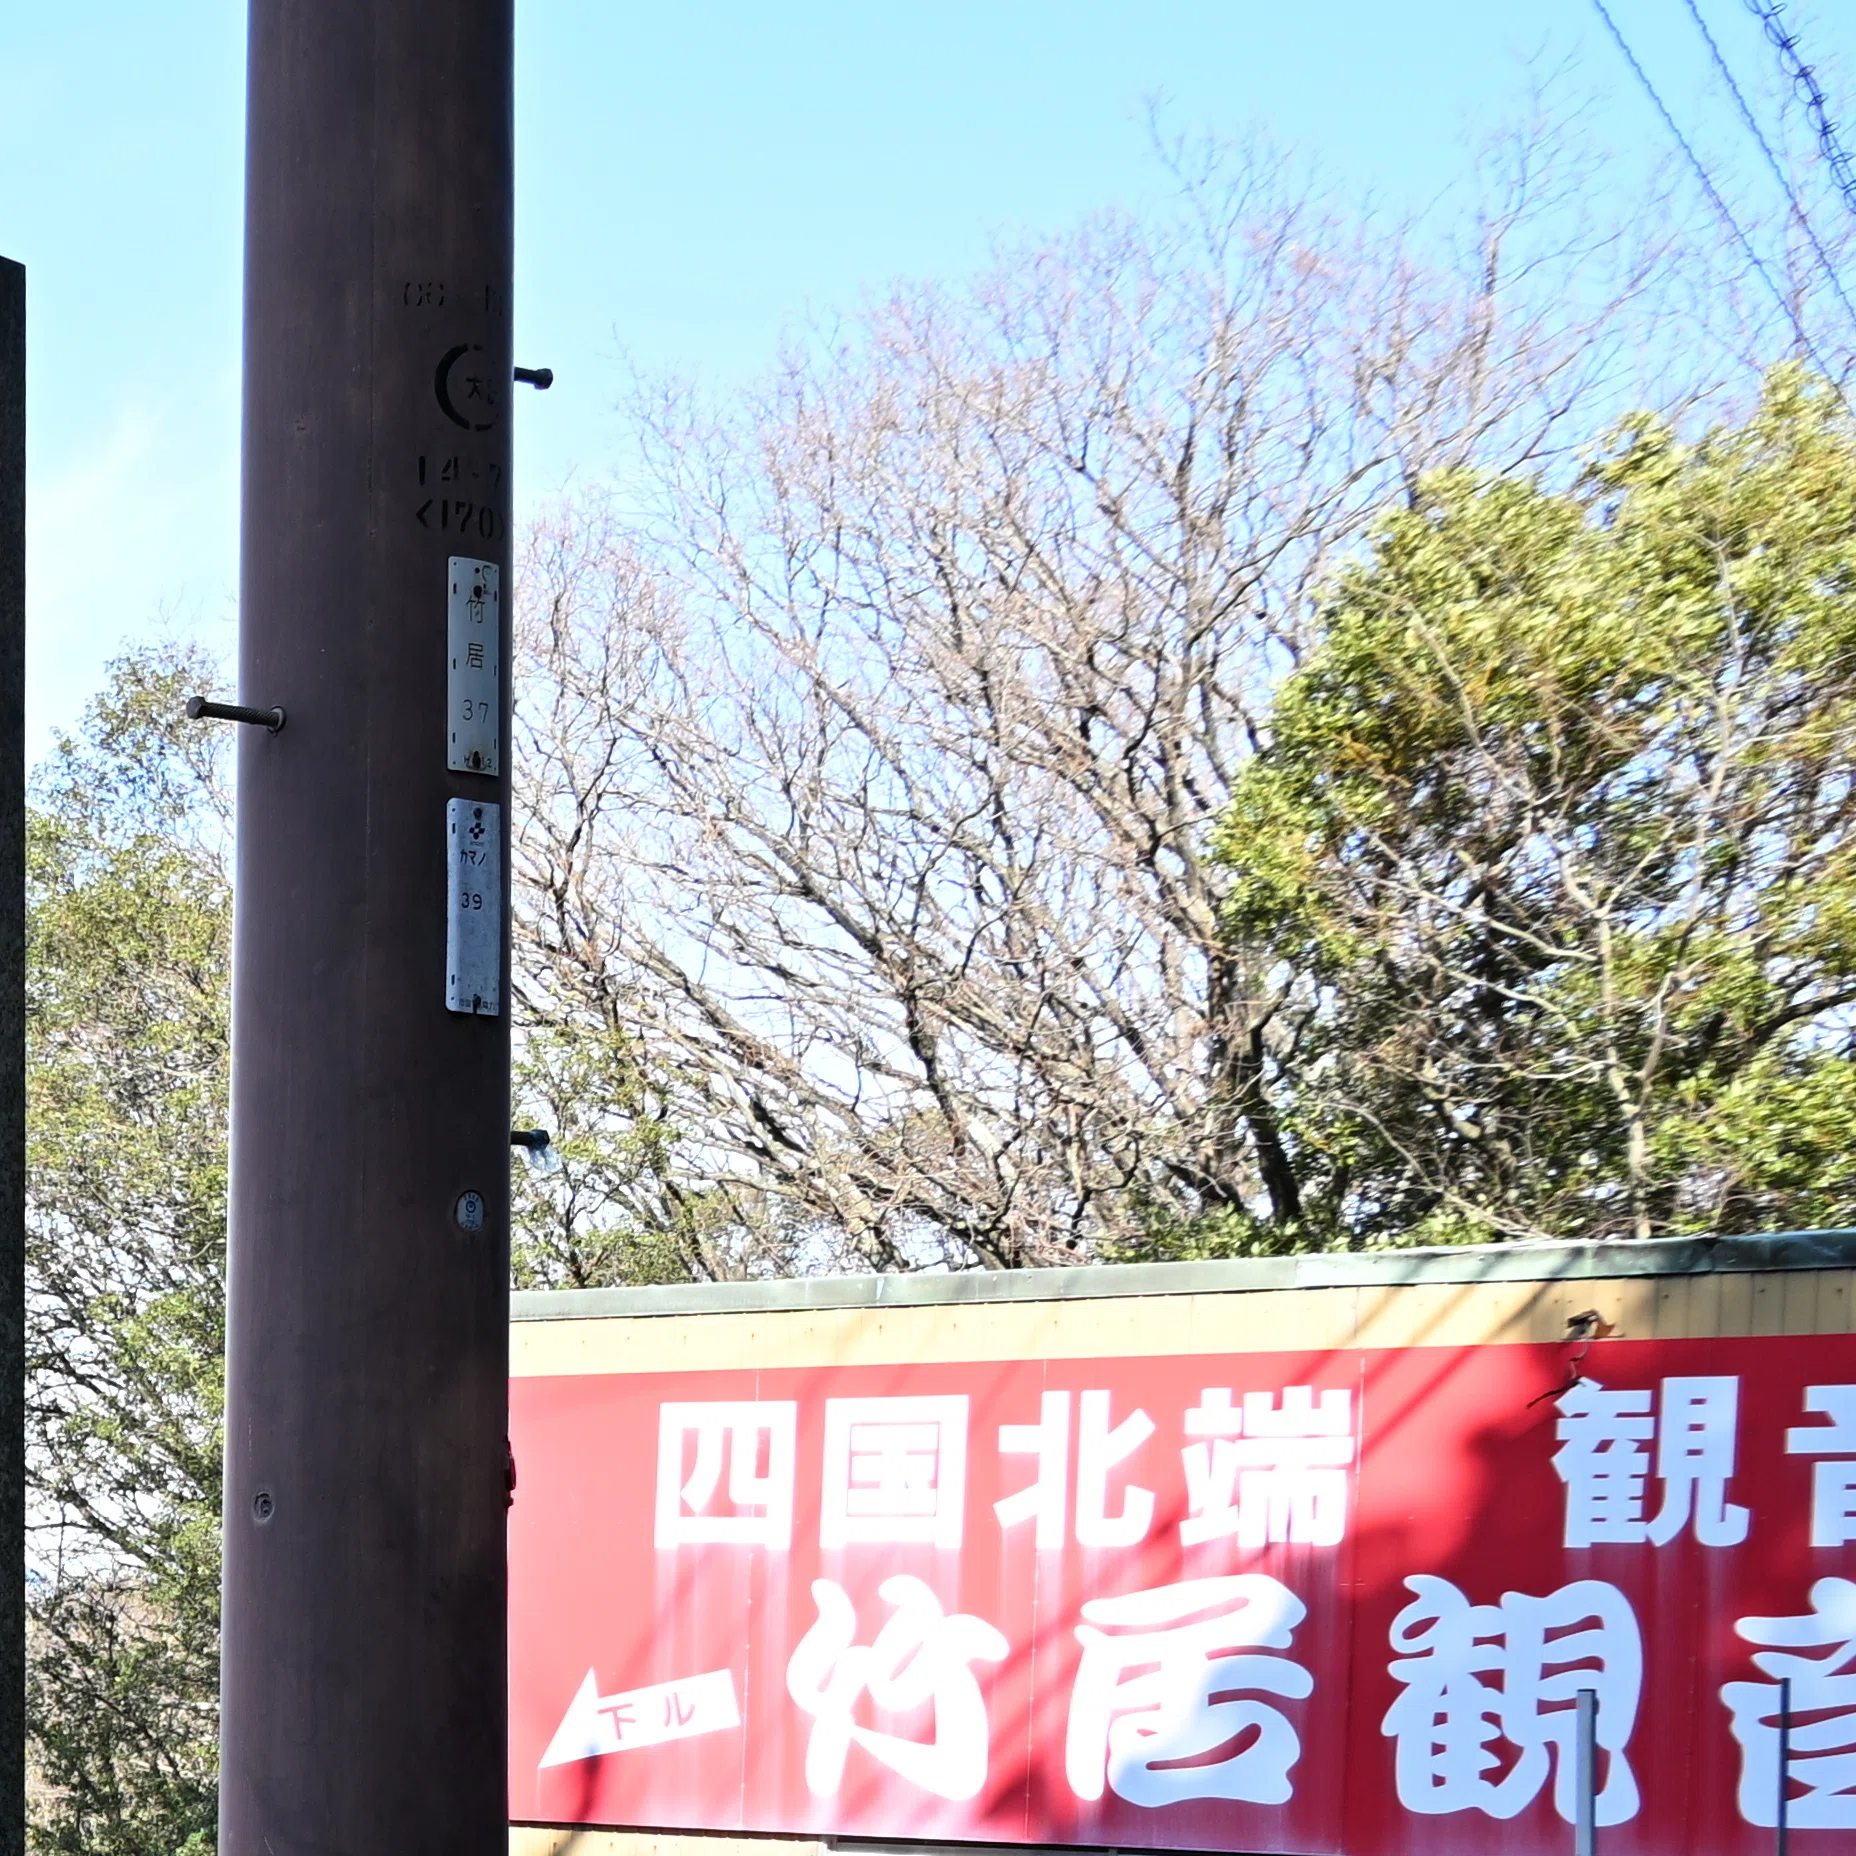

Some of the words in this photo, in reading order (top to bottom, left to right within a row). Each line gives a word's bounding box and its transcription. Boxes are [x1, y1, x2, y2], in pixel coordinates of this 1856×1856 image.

[465, 598, 486, 670] 竹居
[462, 699, 489, 724] 37
[460, 850, 486, 866] カマノ
[461, 892, 483, 910] 39
[653, 1385, 1356, 1549] 四国北端
[598, 1691, 696, 1741] 下ル
